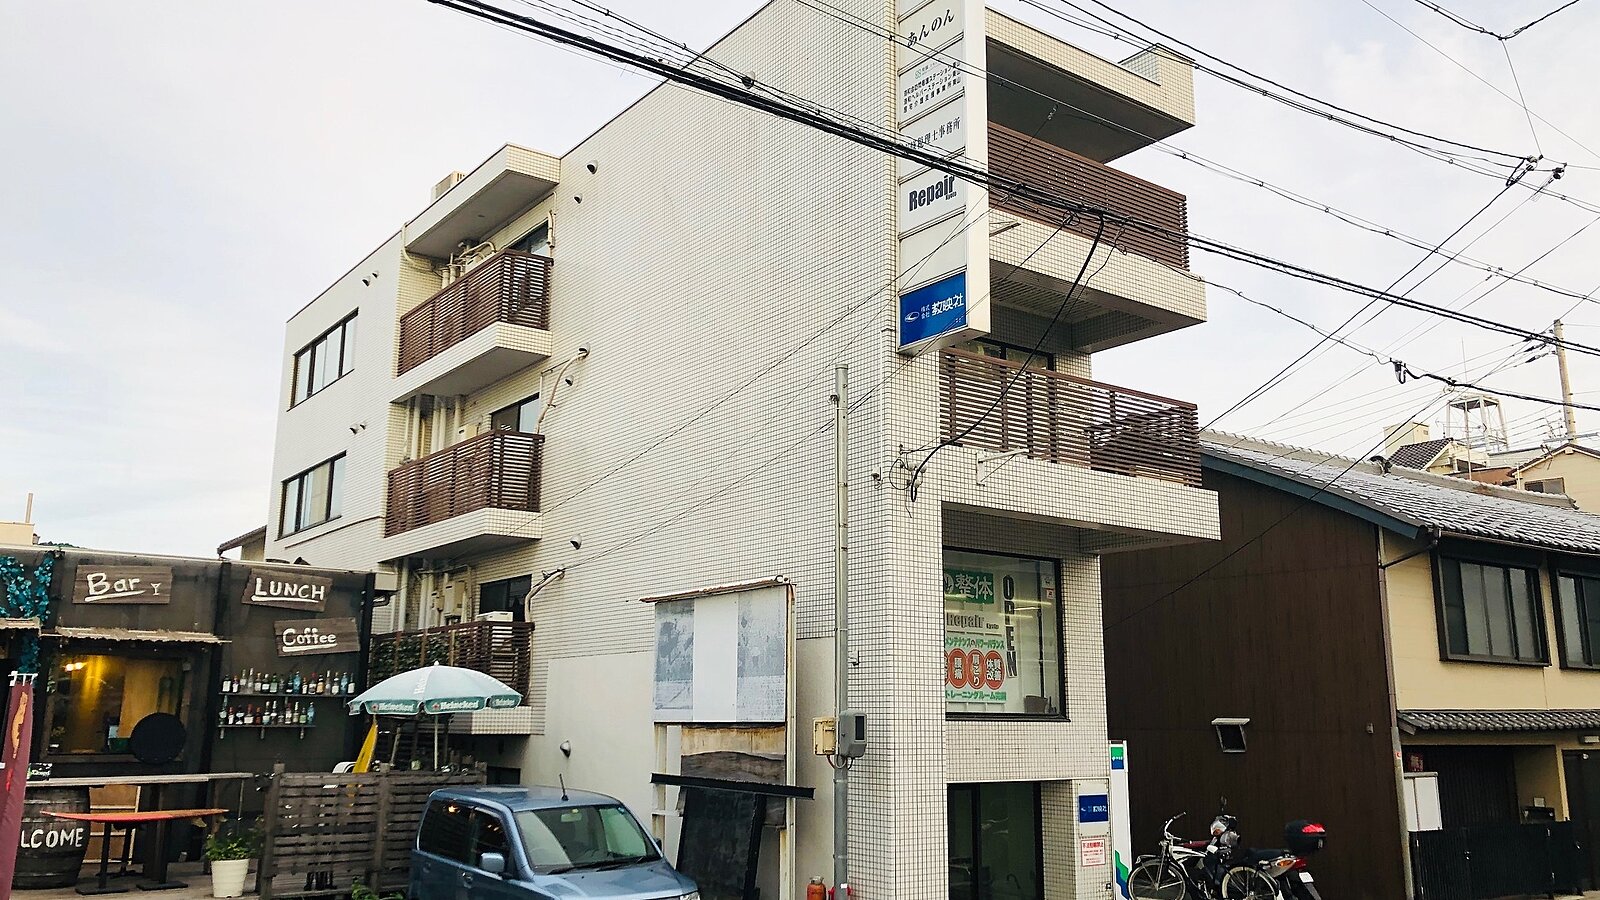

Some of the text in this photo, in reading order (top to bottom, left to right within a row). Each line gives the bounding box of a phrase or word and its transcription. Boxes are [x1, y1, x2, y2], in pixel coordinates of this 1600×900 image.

[907, 9, 955, 47] あんのん
[909, 174, 956, 211] Repair
[86, 572, 141, 595] Bar
[255, 577, 325, 600] LUNCH
[947, 613, 984, 628] Repair
[1003, 575, 1018, 678] OPEN
[282, 627, 337, 646] Coffee
[439, 698, 479, 710] Heineken
[20, 827, 84, 849] LCOME
